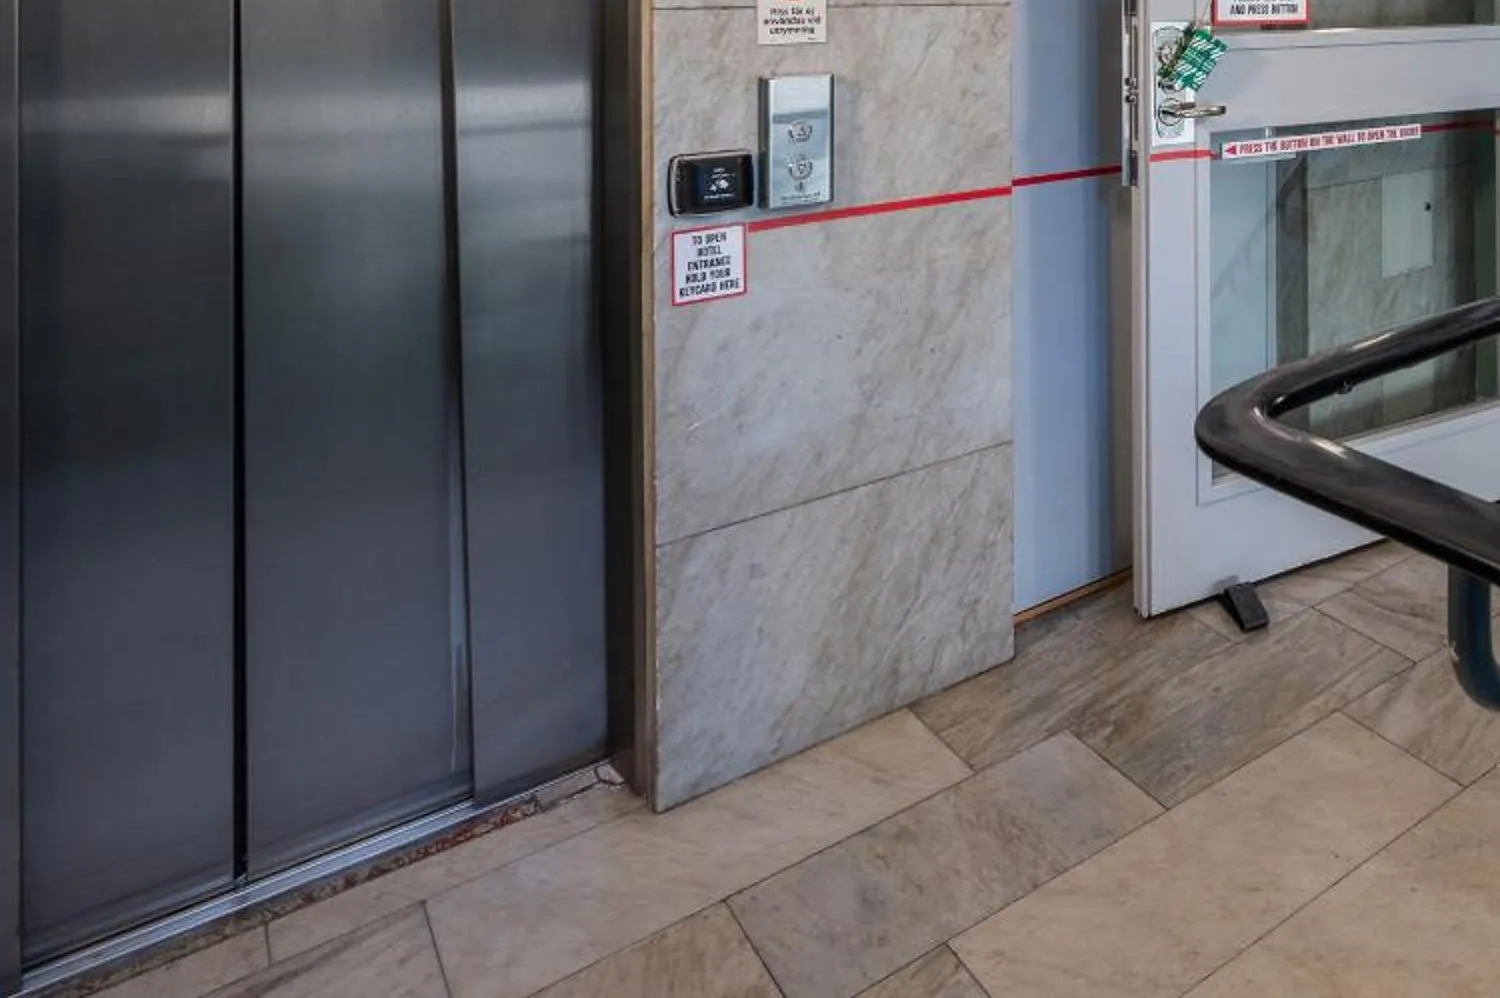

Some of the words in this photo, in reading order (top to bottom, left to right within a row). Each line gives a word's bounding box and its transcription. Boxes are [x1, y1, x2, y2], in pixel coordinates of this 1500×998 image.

[1230, 4, 1246, 15] AND
[1248, 4, 1270, 15] PRESS
[1271, 4, 1299, 14] BUTTON
[1239, 143, 1263, 155] PRESS
[1280, 137, 1309, 151] BUTTON
[1337, 132, 1356, 144] WALL
[692, 234, 703, 246] TO
[706, 231, 727, 244] OPEN
[697, 245, 723, 257] HOTEL
[687, 255, 732, 271] ENTRANCE
[685, 271, 707, 285] HOLD
[709, 267, 731, 280] YOUR
[679, 281, 717, 299] KEYCARD
[720, 277, 740, 291] HERE
